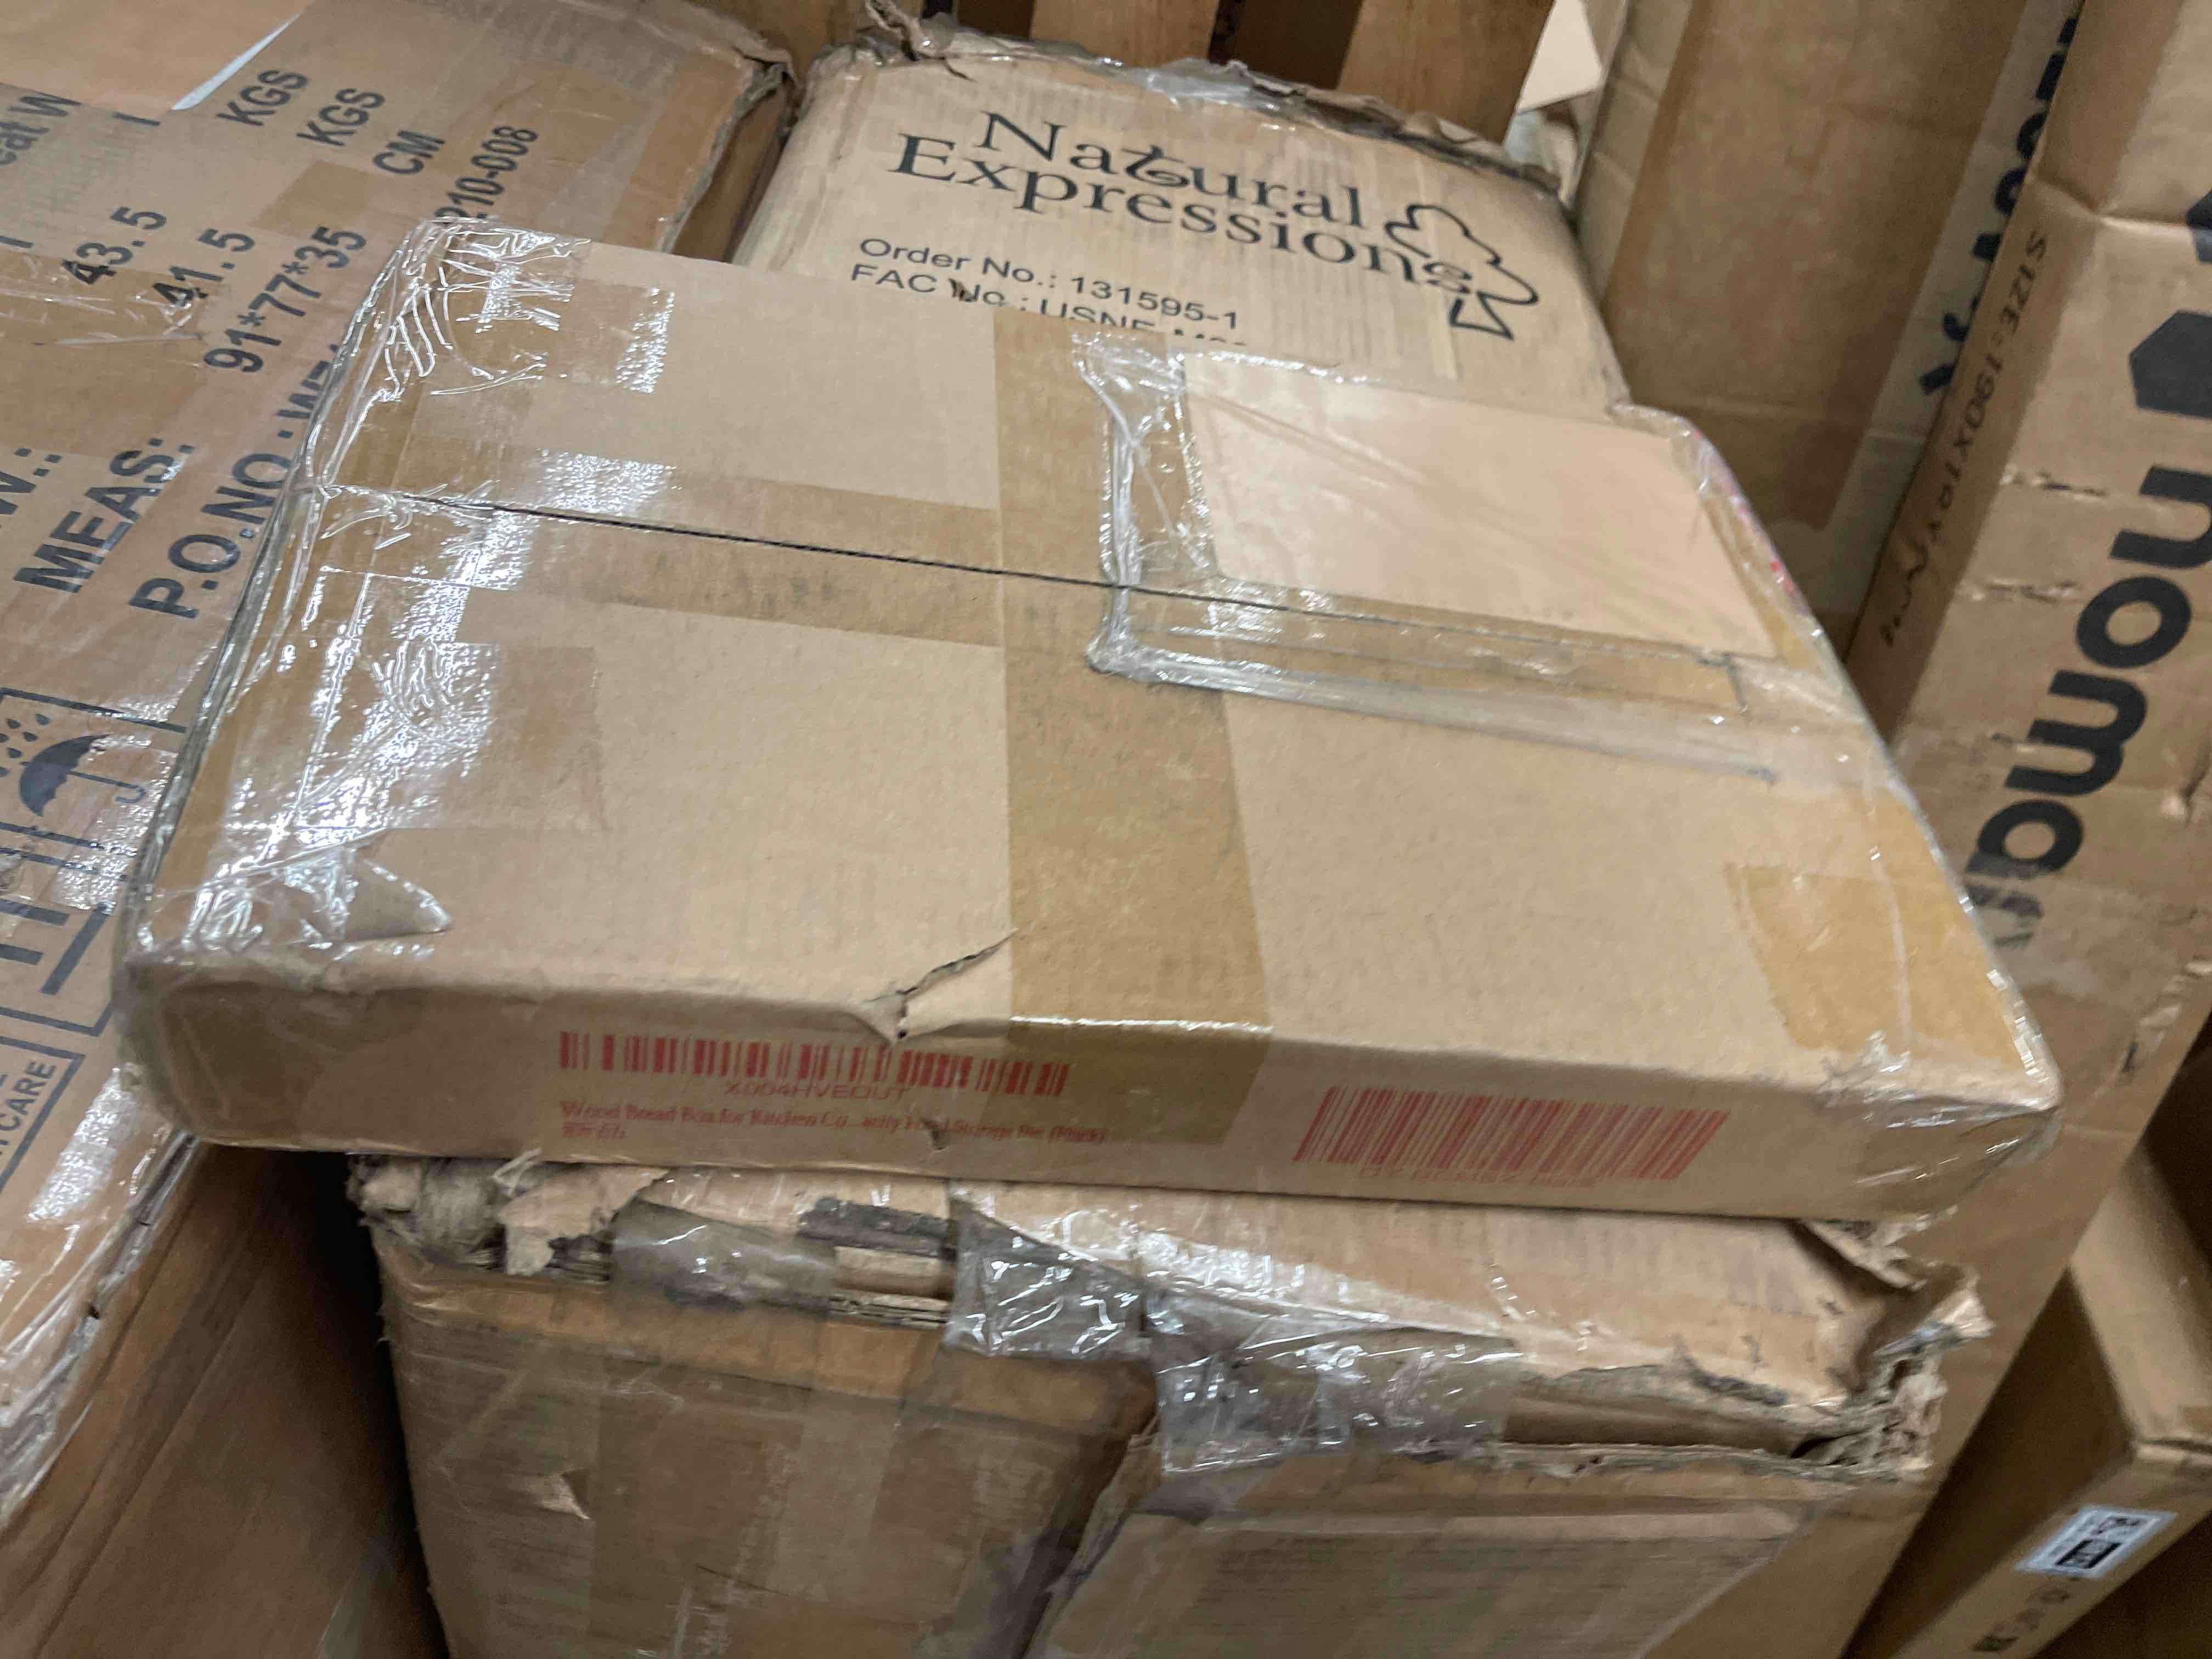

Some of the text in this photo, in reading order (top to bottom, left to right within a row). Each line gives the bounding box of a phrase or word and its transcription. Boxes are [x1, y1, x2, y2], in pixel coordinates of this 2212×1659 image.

[61, 69, 309, 285] 43.5 KGS
[152, 88, 385, 308] 41.5 KGS
[887, 132, 1473, 295] Expressions
[973, 110, 1365, 229] Natural
[850, 263, 937, 294] FAC
[859, 238, 1239, 331] Order No.: 131595-1
[12, 438, 195, 594] MEAS:
[373, 129, 445, 175] CM
